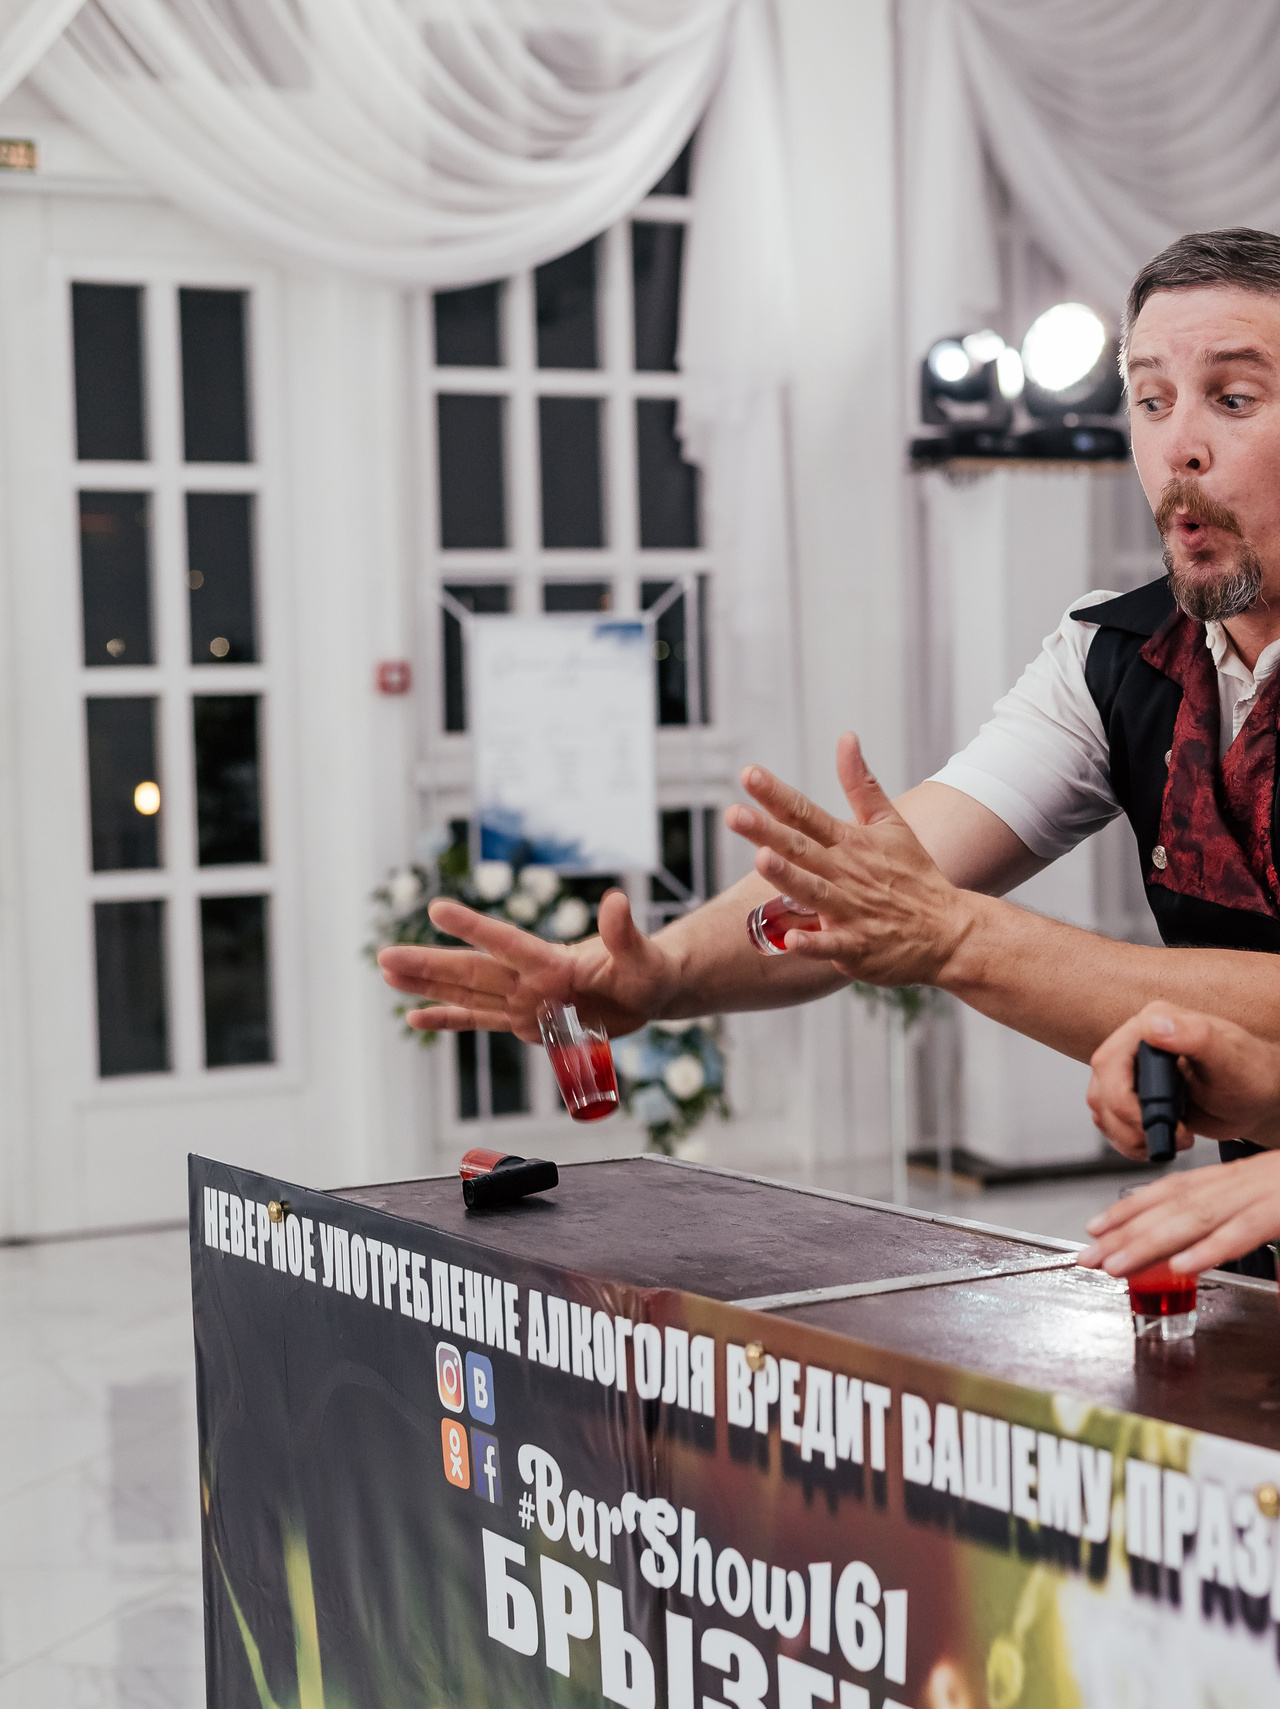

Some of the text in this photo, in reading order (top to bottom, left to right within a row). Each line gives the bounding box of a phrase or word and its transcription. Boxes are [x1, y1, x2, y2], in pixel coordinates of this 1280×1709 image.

[203, 1186, 317, 1283] НЕВЕРНОЕ
[319, 1222, 521, 1357] УПОТРЕБЛЕНИЕ
[528, 1289, 716, 1418] АЛКОГОЛЯ
[726, 1343, 892, 1471] ВРЕДИТ
[902, 1393, 1112, 1544] ВАШЕМУ
[482, 1527, 914, 1709] БРЫЗ
